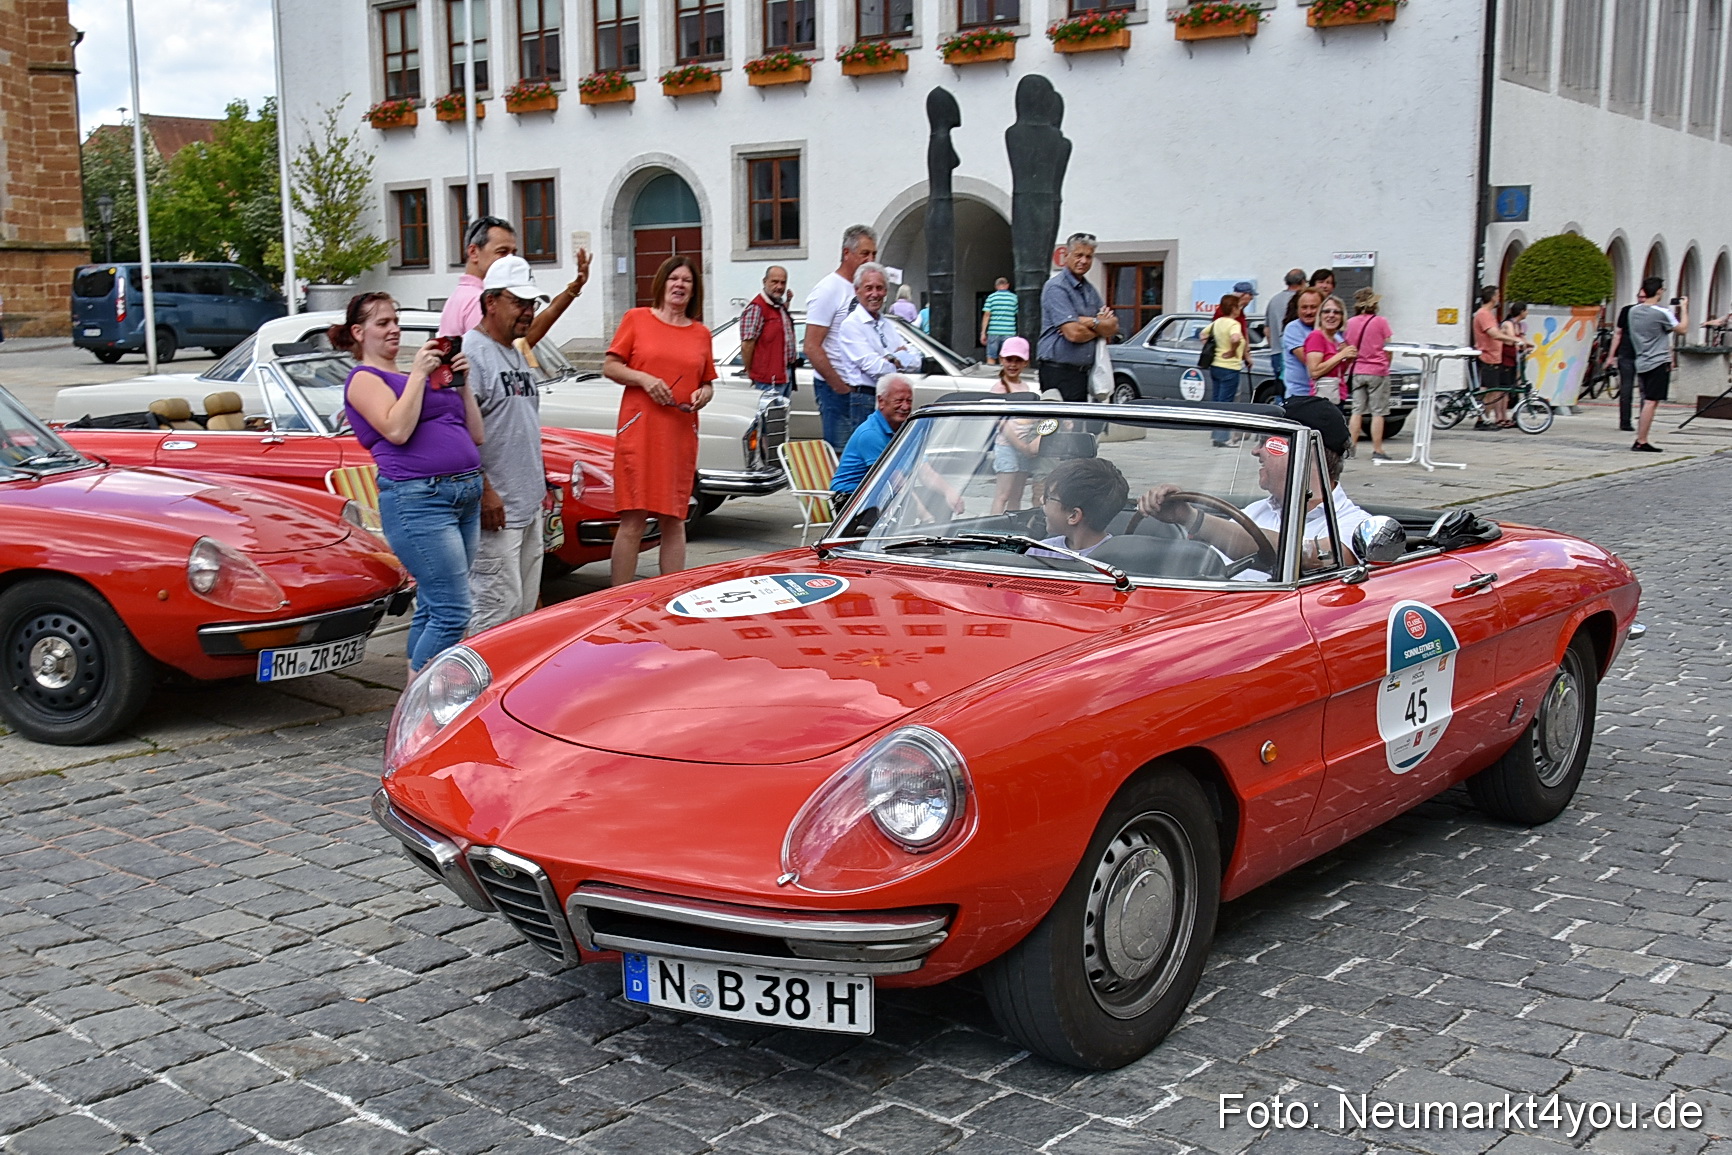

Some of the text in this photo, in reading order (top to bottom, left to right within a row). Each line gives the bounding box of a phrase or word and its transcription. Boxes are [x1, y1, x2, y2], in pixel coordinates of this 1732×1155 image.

[274, 652, 298, 677] RH
[309, 647, 330, 672] ZR
[331, 641, 358, 667] 523
[1404, 687, 1428, 727] 45
[632, 979, 643, 992] D
[658, 960, 686, 1004] N
[826, 981, 856, 1025] H
